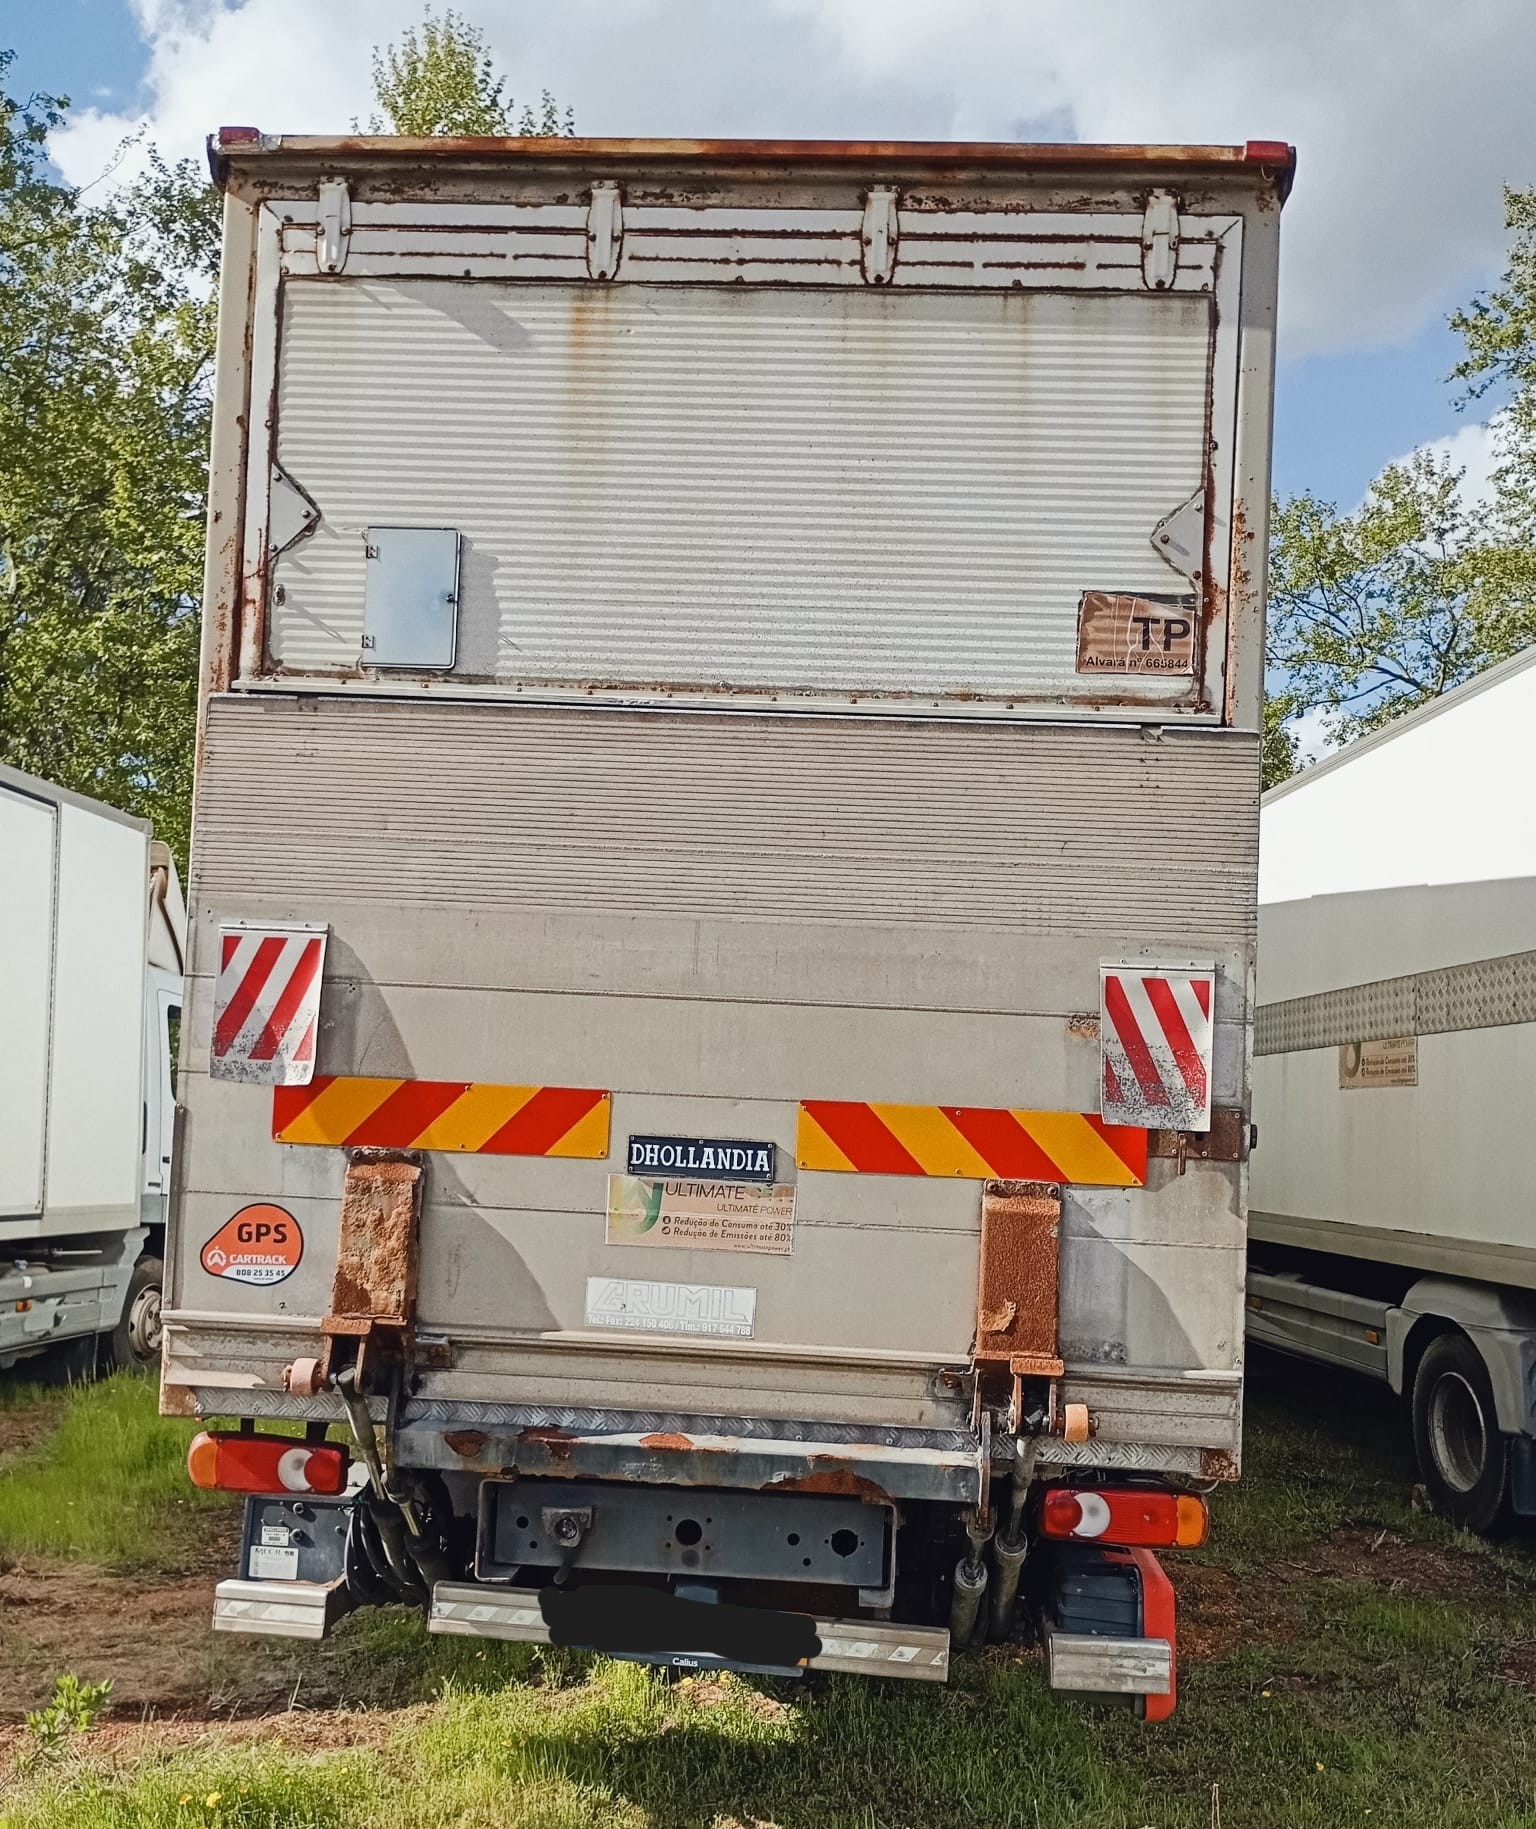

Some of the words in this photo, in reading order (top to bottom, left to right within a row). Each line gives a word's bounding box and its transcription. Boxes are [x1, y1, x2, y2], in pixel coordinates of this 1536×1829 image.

[1132, 616, 1190, 652] TP
[1086, 656, 1125, 668] Alvará
[1146, 658, 1188, 669] 665844
[630, 1143, 770, 1172] DHOLLANDIA
[665, 1181, 746, 1200] ULTIMATE
[716, 1203, 758, 1214] ULTIMATE
[759, 1206, 793, 1216] POWER
[673, 1216, 708, 1229] Redução
[721, 1219, 758, 1230] Consumo
[759, 1222, 773, 1231] até
[237, 1222, 288, 1244] GPS
[673, 1226, 707, 1239] Redução
[720, 1229, 757, 1241] Emissões
[229, 1254, 287, 1265] CARTRACK
[253, 1269, 263, 1277] 25
[624, 1317, 640, 1328] 224
[702, 1322, 717, 1334] 917
[672, 1657, 698, 1667] Calius
